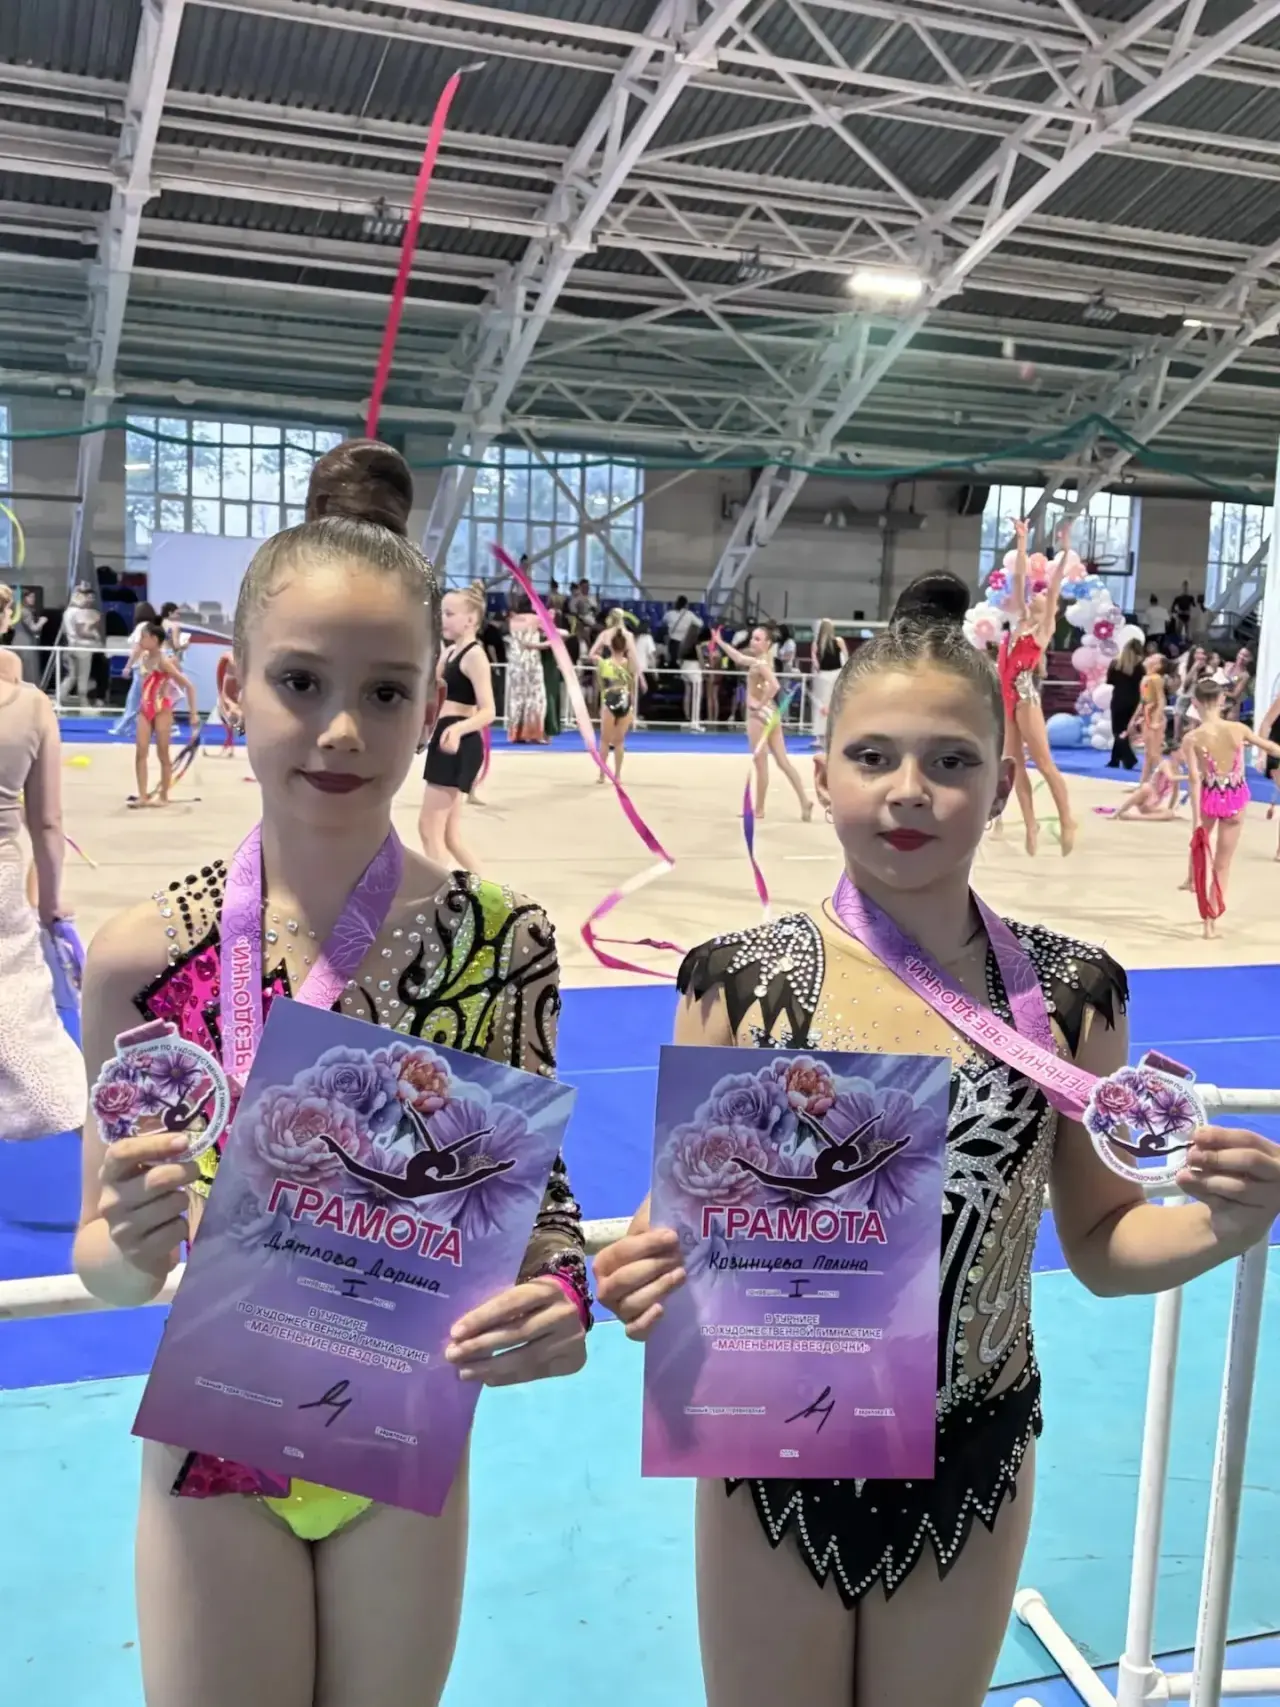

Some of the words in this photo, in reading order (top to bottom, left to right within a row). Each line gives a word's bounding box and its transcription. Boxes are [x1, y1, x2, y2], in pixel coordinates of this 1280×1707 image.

[231, 935, 253, 1073] ВЕЗДОЧКИ»
[904, 955, 1009, 1048] ЗВЕЗДОЧКИ»
[1008, 1043, 1093, 1094] ЛЕНЬКИЕ
[266, 1178, 463, 1267] ГРАМОТА
[702, 1205, 887, 1244] ГРАМОТА
[263, 1231, 358, 1269] Дятлова
[364, 1257, 441, 1293] Дарина
[813, 1255, 868, 1271] Полина
[238, 1301, 254, 1315] ПО
[255, 1306, 358, 1341] ХУДОЖЕСТВЕННОЙ
[359, 1334, 430, 1363] ГИМНАСТИКЕ
[308, 1306, 318, 1318] В
[319, 1309, 368, 1331] ТУРНИРЕ
[701, 1325, 716, 1336] ПО
[718, 1325, 814, 1338] ХУДОЖЕСТВЕННОЙ
[815, 1327, 883, 1339] ГИМНАСТИКЕ
[764, 1314, 773, 1324] В
[774, 1314, 820, 1325] ТУРНИРЕ
[244, 1319, 330, 1352] «МАЛЕНЬКИЕ
[329, 1341, 412, 1374] ЗВЕЗДОЧКИ»
[712, 1339, 791, 1352] «МАЛЕНЬКИЕ
[792, 1339, 871, 1354] ЗВЕЗДОЧКИ»
